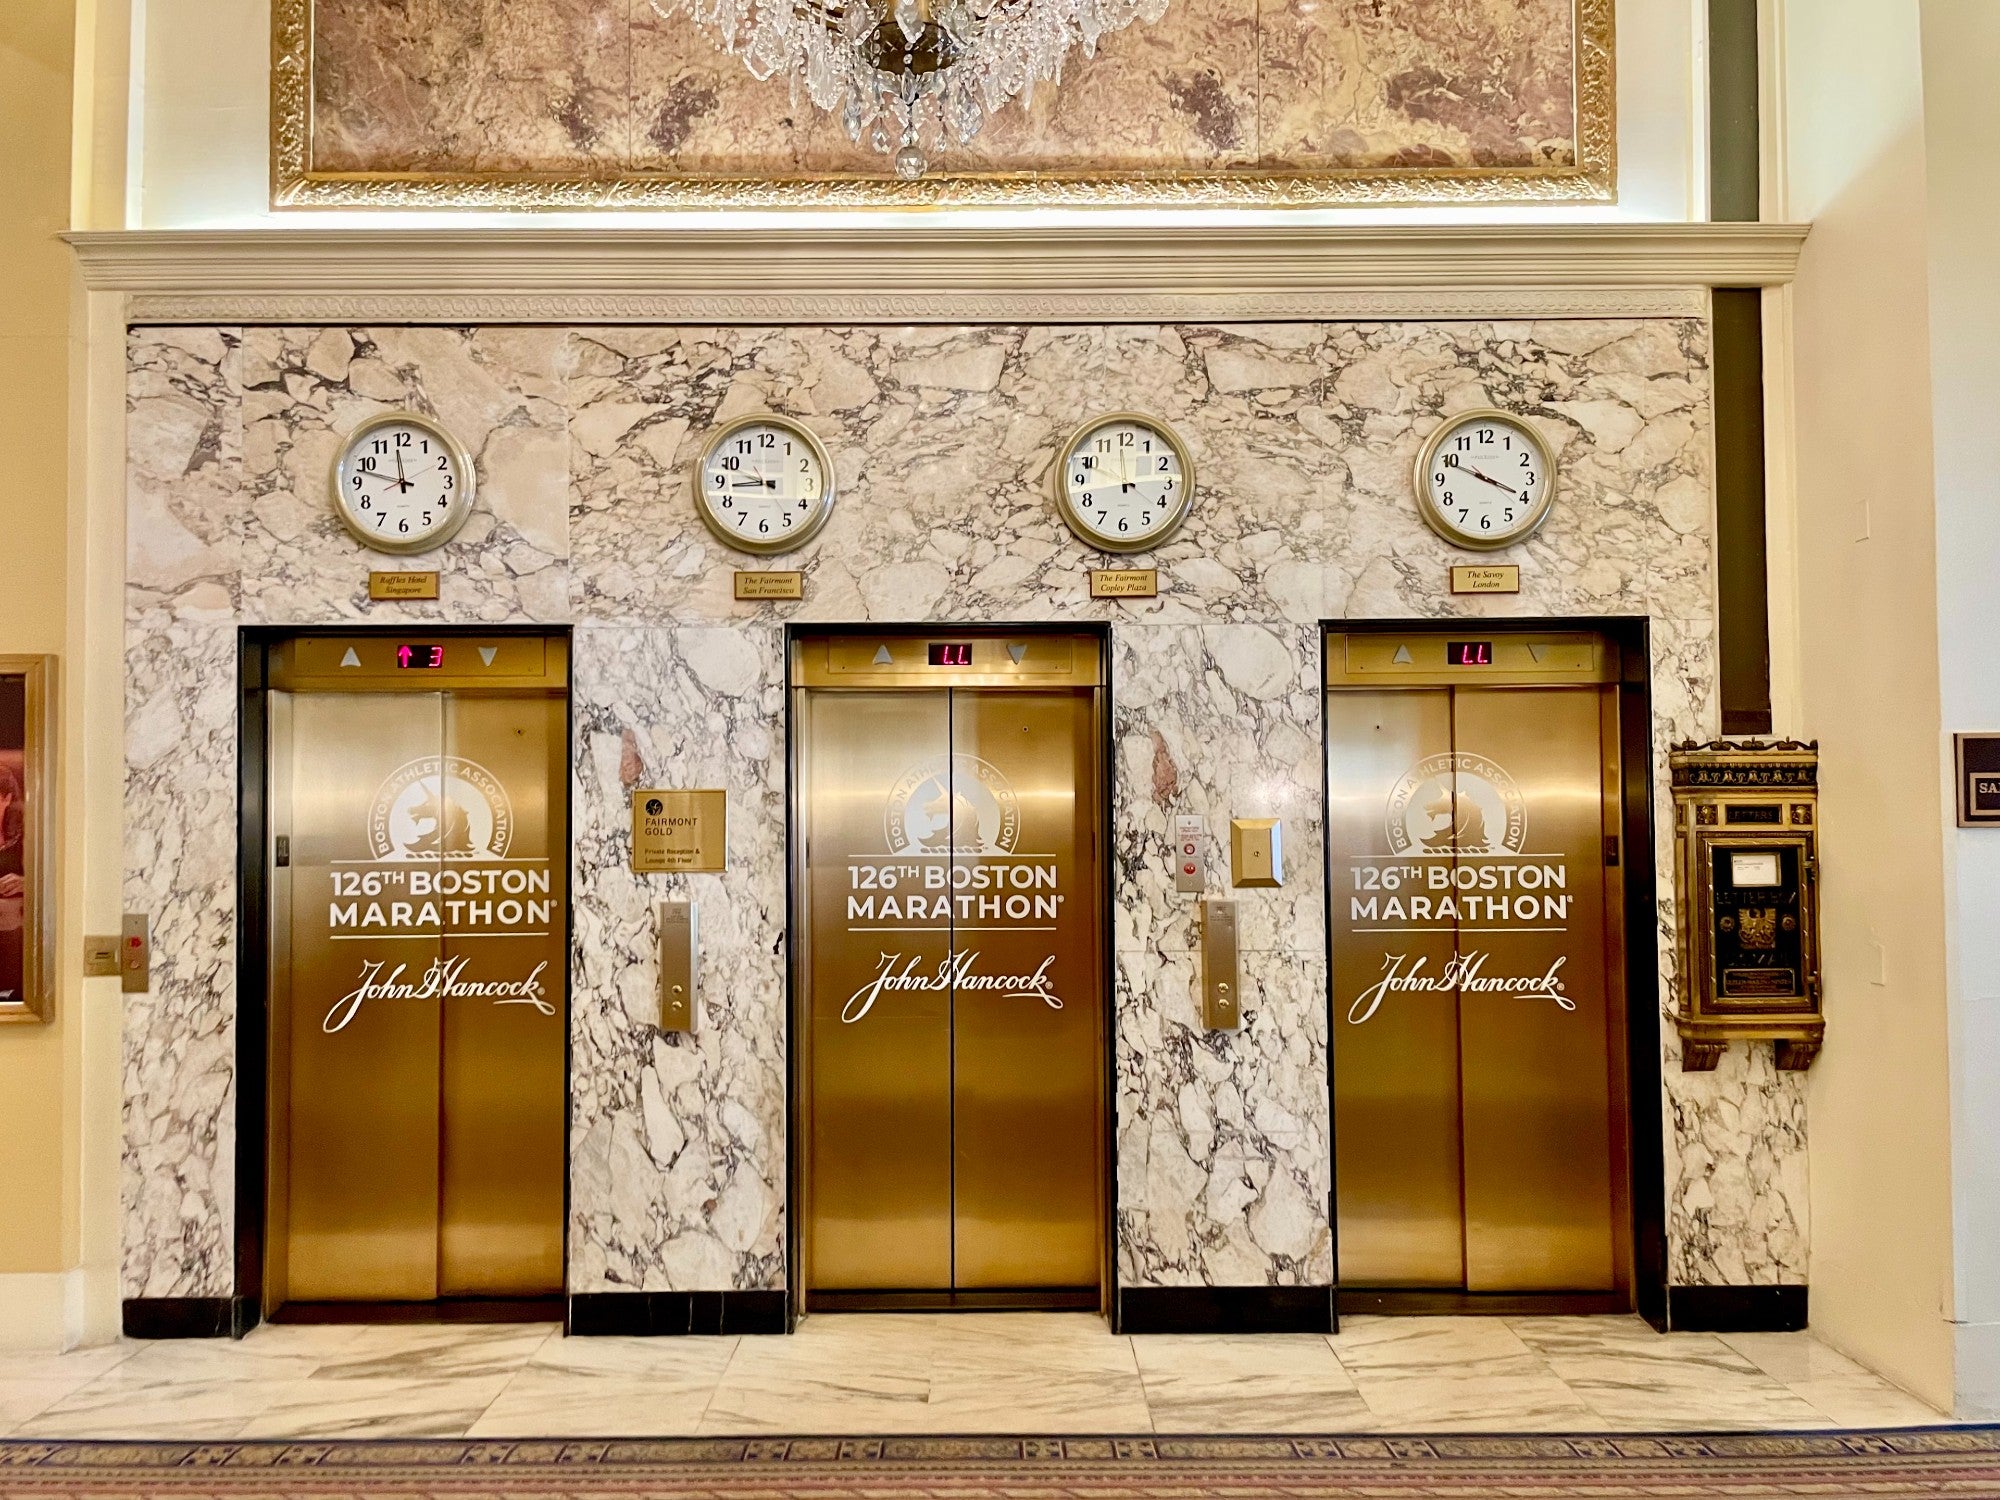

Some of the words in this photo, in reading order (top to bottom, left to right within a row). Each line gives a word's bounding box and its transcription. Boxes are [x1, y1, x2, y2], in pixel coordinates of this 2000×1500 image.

[393, 433, 411, 446] 12
[758, 434, 774, 448] 12
[1117, 433, 1134, 446] 12
[1476, 430, 1494, 443] 12
[372, 440, 388, 454] 11
[420, 440, 428, 454] 1
[736, 440, 752, 454] 11
[784, 442, 791, 455] 1
[1096, 439, 1111, 452] 11
[1143, 441, 1150, 453] 1
[1455, 437, 1470, 450] 11
[1503, 437, 1510, 450] 1
[358, 457, 376, 471] 10
[438, 456, 447, 470] 2
[722, 457, 739, 470] 10
[800, 459, 808, 472] 2
[1159, 457, 1168, 470] 2
[1442, 454, 1459, 467] 10
[1520, 453, 1529, 466] 2
[352, 476, 362, 490] 9
[444, 475, 453, 489] 3
[716, 475, 725, 489] 9
[805, 478, 813, 492] 3
[1076, 474, 1084, 485] 9
[1164, 477, 1172, 490] 3
[1435, 473, 1445, 486] 9
[1526, 472, 1534, 485] 3
[361, 495, 371, 509] 8
[438, 495, 447, 507] 4
[723, 496, 732, 508] 8
[798, 499, 807, 509] 4
[1082, 493, 1092, 507] 8
[1157, 495, 1166, 508] 4
[1443, 492, 1453, 505] 8
[1519, 491, 1529, 504] 4
[377, 513, 386, 527] 7
[422, 512, 431, 525] 5
[738, 512, 747, 526] 7
[783, 514, 791, 527] 5
[1097, 511, 1107, 525] 7
[1142, 512, 1150, 525] 5
[1459, 509, 1468, 523] 7
[1504, 508, 1513, 521] 5
[399, 519, 408, 532] 6
[759, 519, 768, 533] 6
[1118, 518, 1128, 531] 6
[1481, 515, 1490, 529] 6
[380, 576, 406, 585] Raffles
[1483, 571, 1504, 579] Savoy
[385, 586, 422, 594] Singapore
[1101, 584, 1125, 593] Copley
[429, 646, 443, 667] 3
[944, 645, 968, 664] LL
[1463, 645, 1488, 664] LL
[1979, 783, 2000, 793] SA
[460, 766, 507, 852] ASSOCIATION
[645, 818, 698, 826] FAIRMONT
[645, 828, 672, 836] GOLD
[330, 871, 405, 896] 126TH
[409, 870, 550, 895] BOSTON
[848, 865, 919, 889] 126TH
[925, 865, 1057, 889] BOSTON
[1350, 866, 1422, 890] 126TH
[1428, 865, 1565, 890] BOSTON
[842, 950, 930, 1023] John
[928, 948, 1063, 1009] Hancock
[1348, 952, 1436, 1025] John
[1434, 950, 1576, 1011] Hancock
[323, 959, 415, 1033] John
[414, 955, 556, 1016] Hancock
